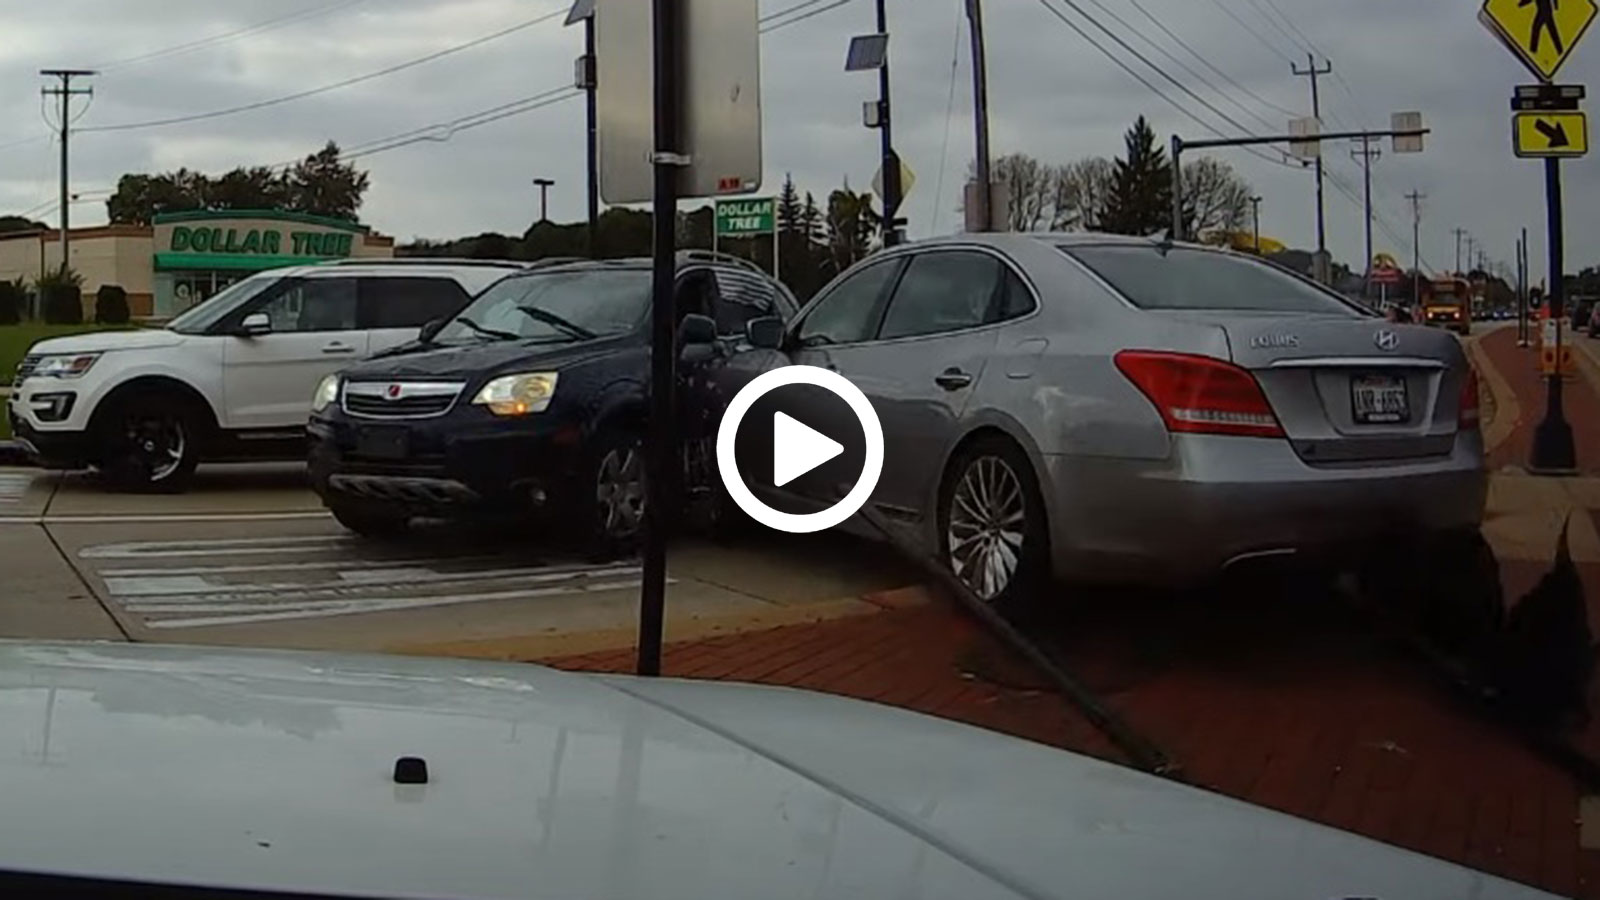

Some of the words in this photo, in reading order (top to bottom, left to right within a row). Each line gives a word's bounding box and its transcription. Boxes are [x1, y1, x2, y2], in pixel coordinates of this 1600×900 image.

[718, 202, 771, 216] DOLLAR
[728, 217, 760, 229] TREE
[171, 226, 280, 254] DOLLAR
[291, 232, 354, 256] TREE
